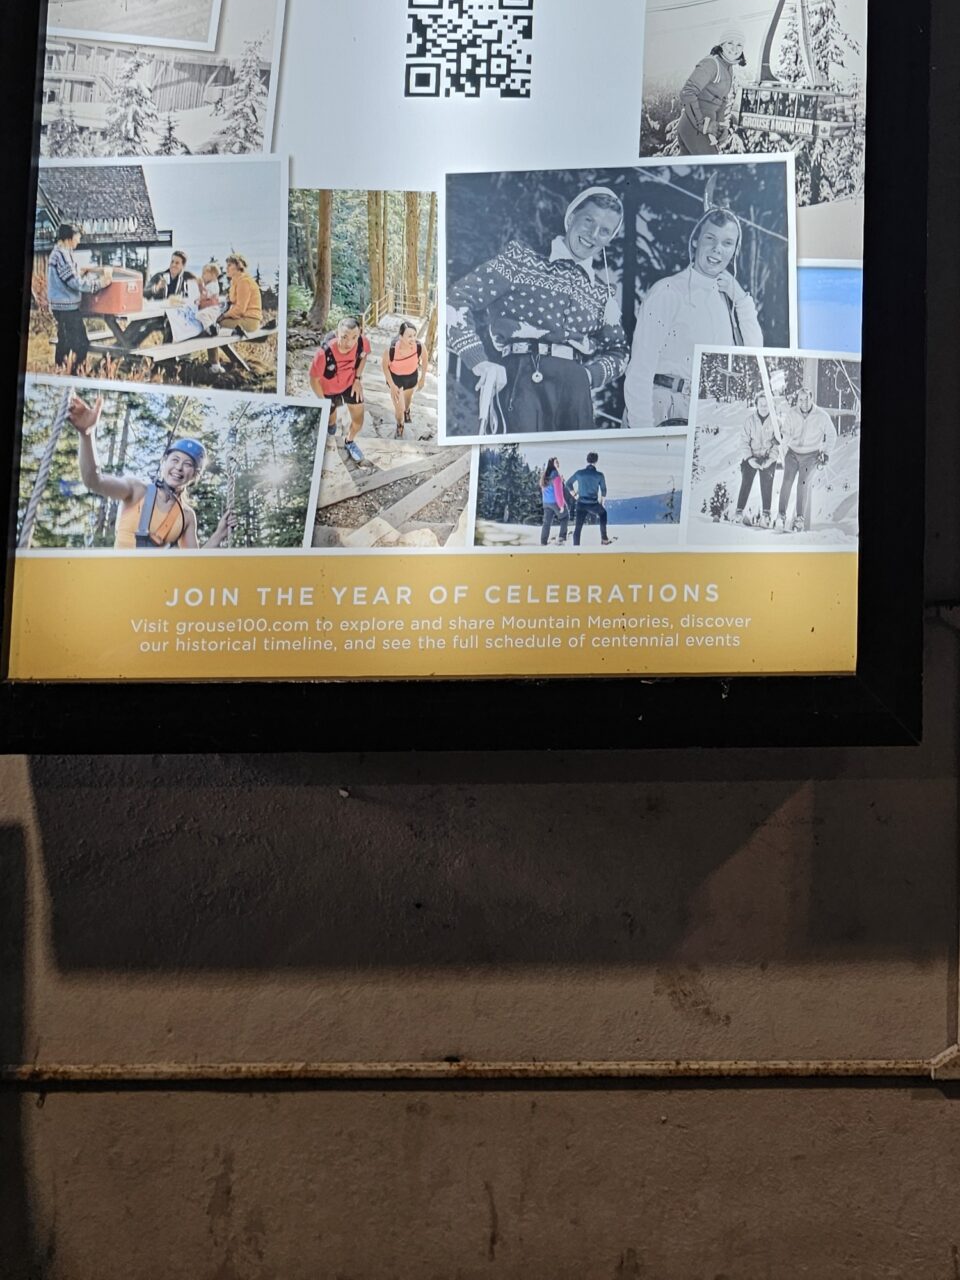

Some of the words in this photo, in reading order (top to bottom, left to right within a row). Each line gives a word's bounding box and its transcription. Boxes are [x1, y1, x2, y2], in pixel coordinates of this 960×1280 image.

[166, 587, 239, 607] JOIN
[257, 587, 314, 606] THE
[331, 586, 412, 605] YEAR
[429, 585, 469, 604] OF
[484, 583, 719, 604] CELEBRATIONS
[130, 618, 169, 634] Visit
[175, 618, 309, 635] grouse100.com
[316, 618, 333, 631] to
[339, 617, 405, 633] explore
[410, 616, 442, 631] and
[449, 616, 495, 630] share
[502, 616, 580, 629] Mountain
[587, 615, 674, 630] Memories,
[680, 614, 752, 629] discover
[139, 639, 169, 652] our
[175, 637, 257, 652] historical
[263, 636, 337, 652] timeline,
[343, 636, 375, 650] and
[382, 638, 411, 650] see
[418, 636, 446, 650] the
[452, 635, 478, 649] full
[485, 634, 561, 648] schedule
[568, 634, 586, 648] of
[591, 633, 679, 648] centennial
[686, 635, 740, 647] events
